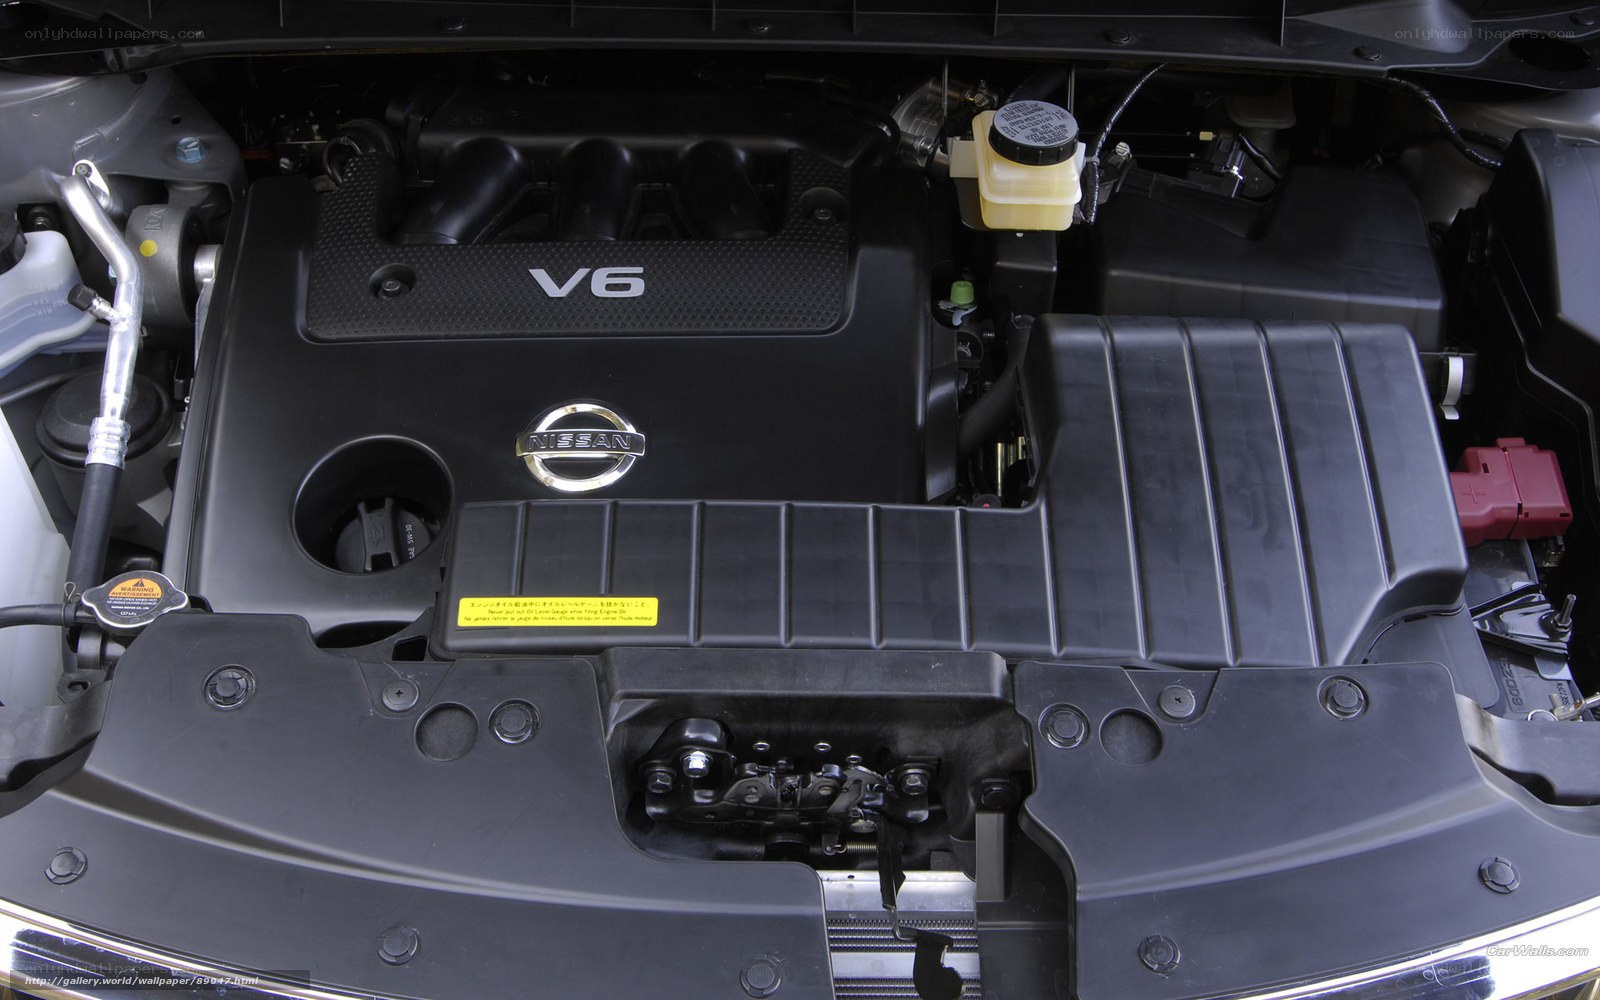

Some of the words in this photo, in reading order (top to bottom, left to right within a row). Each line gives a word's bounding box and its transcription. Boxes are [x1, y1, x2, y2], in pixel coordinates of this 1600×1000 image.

[528, 267, 645, 298] V6
[528, 433, 631, 450] NISSAN
[405, 524, 414, 544] 5W-30
